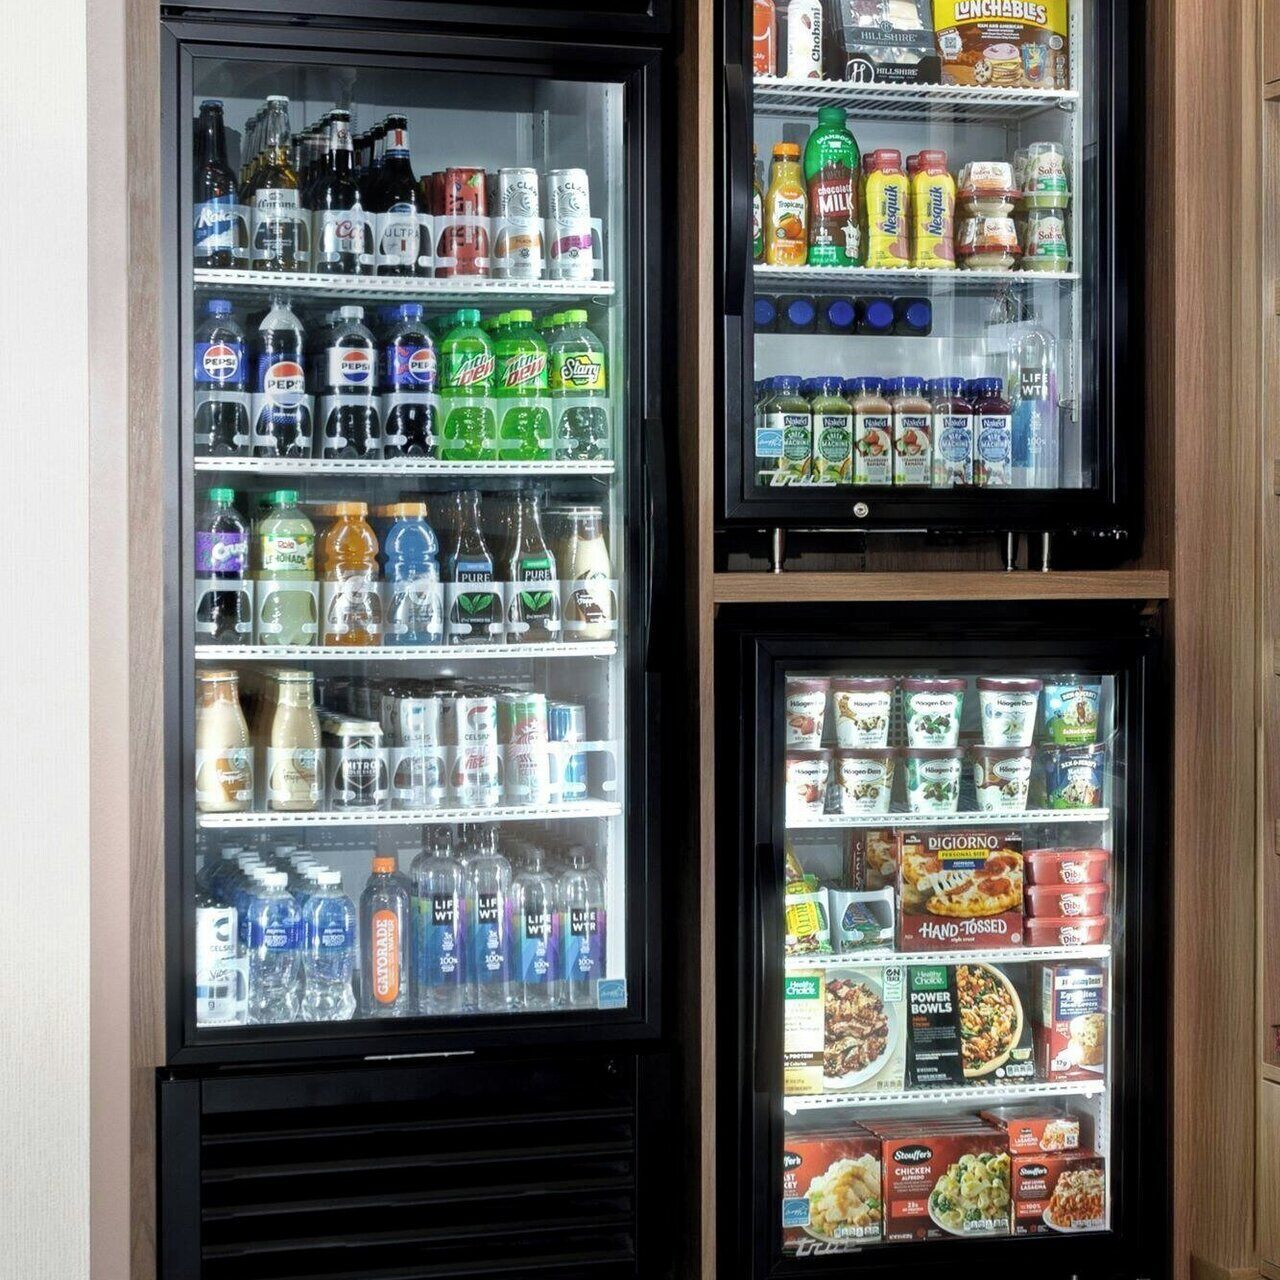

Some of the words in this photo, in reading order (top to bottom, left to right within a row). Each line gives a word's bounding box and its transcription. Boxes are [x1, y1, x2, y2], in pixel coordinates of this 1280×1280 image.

[955, 0, 1046, 23] LUNCHABLES
[811, 7, 821, 62] Chobani
[861, 31, 916, 42] HILLSHIRE
[819, 194, 855, 214] MILK
[884, 185, 898, 234] Nesquik
[928, 186, 942, 235] Nesquik
[205, 358, 236, 366] PEPSI
[563, 359, 600, 383] Starry
[462, 573, 490, 582] PURE
[525, 570, 550, 579] PURE
[435, 900, 459, 909] LIF
[479, 898, 503, 908] LIF
[573, 912, 596, 921] LIFE
[573, 922, 596, 931] WTR
[377, 920, 388, 995] GATORADE
[917, 970, 942, 979] Healthy
[914, 975, 944, 985] Choice
[911, 992, 950, 1003] POWER
[911, 1003, 952, 1014] BOWLS
[895, 1150, 931, 1160] Stouffer's
[895, 1167, 931, 1175] CHICKEN
